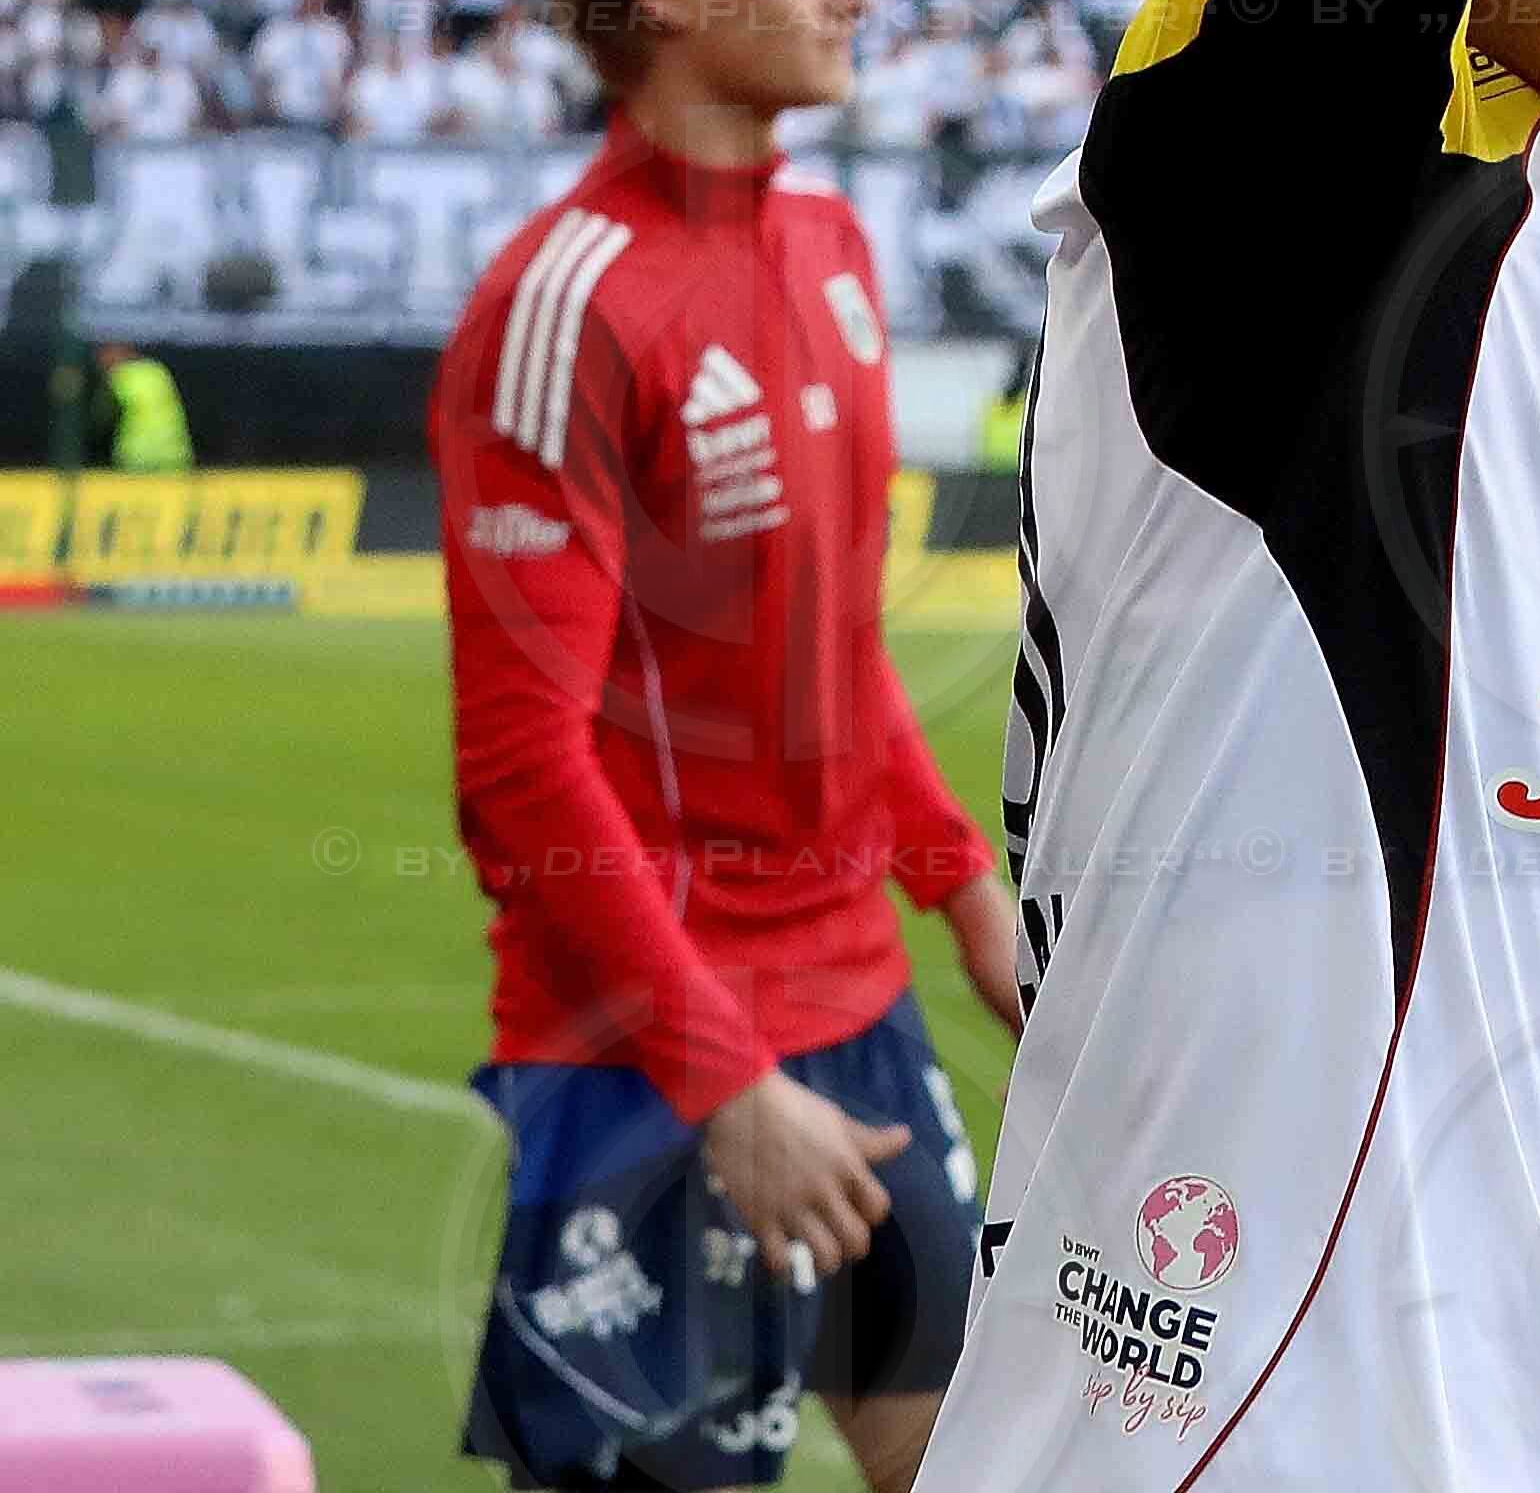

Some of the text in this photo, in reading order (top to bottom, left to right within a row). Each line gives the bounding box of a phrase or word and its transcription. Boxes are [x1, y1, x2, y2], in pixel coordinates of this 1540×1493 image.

[1074, 1243, 1100, 1262] BWT
[1055, 1302, 1081, 1326] THE
[1058, 1260, 1218, 1352] CHANGE
[1081, 1314, 1203, 1390] WORLD
